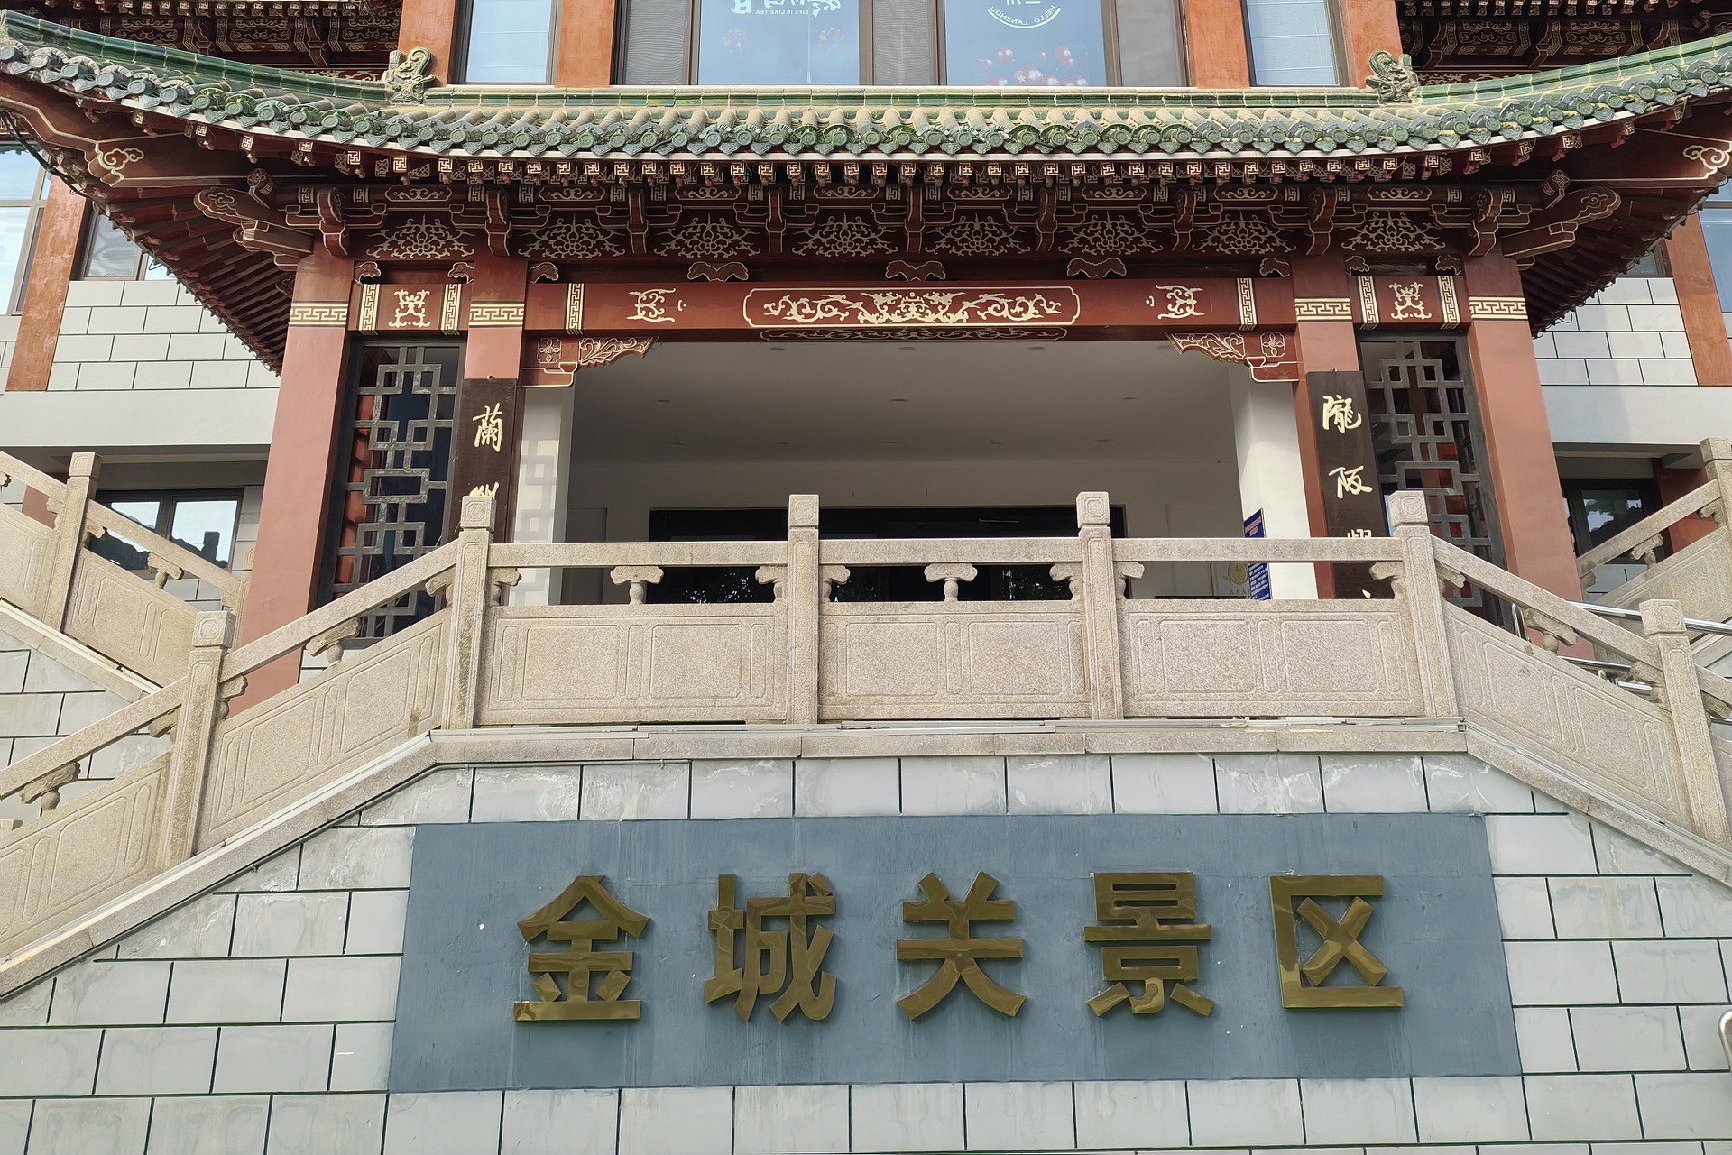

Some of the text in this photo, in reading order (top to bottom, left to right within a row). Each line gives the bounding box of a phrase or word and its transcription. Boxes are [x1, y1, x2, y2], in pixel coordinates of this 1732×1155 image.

[1321, 394, 1373, 538] 隴阪
[513, 868, 1405, 1024] 金城关景区
